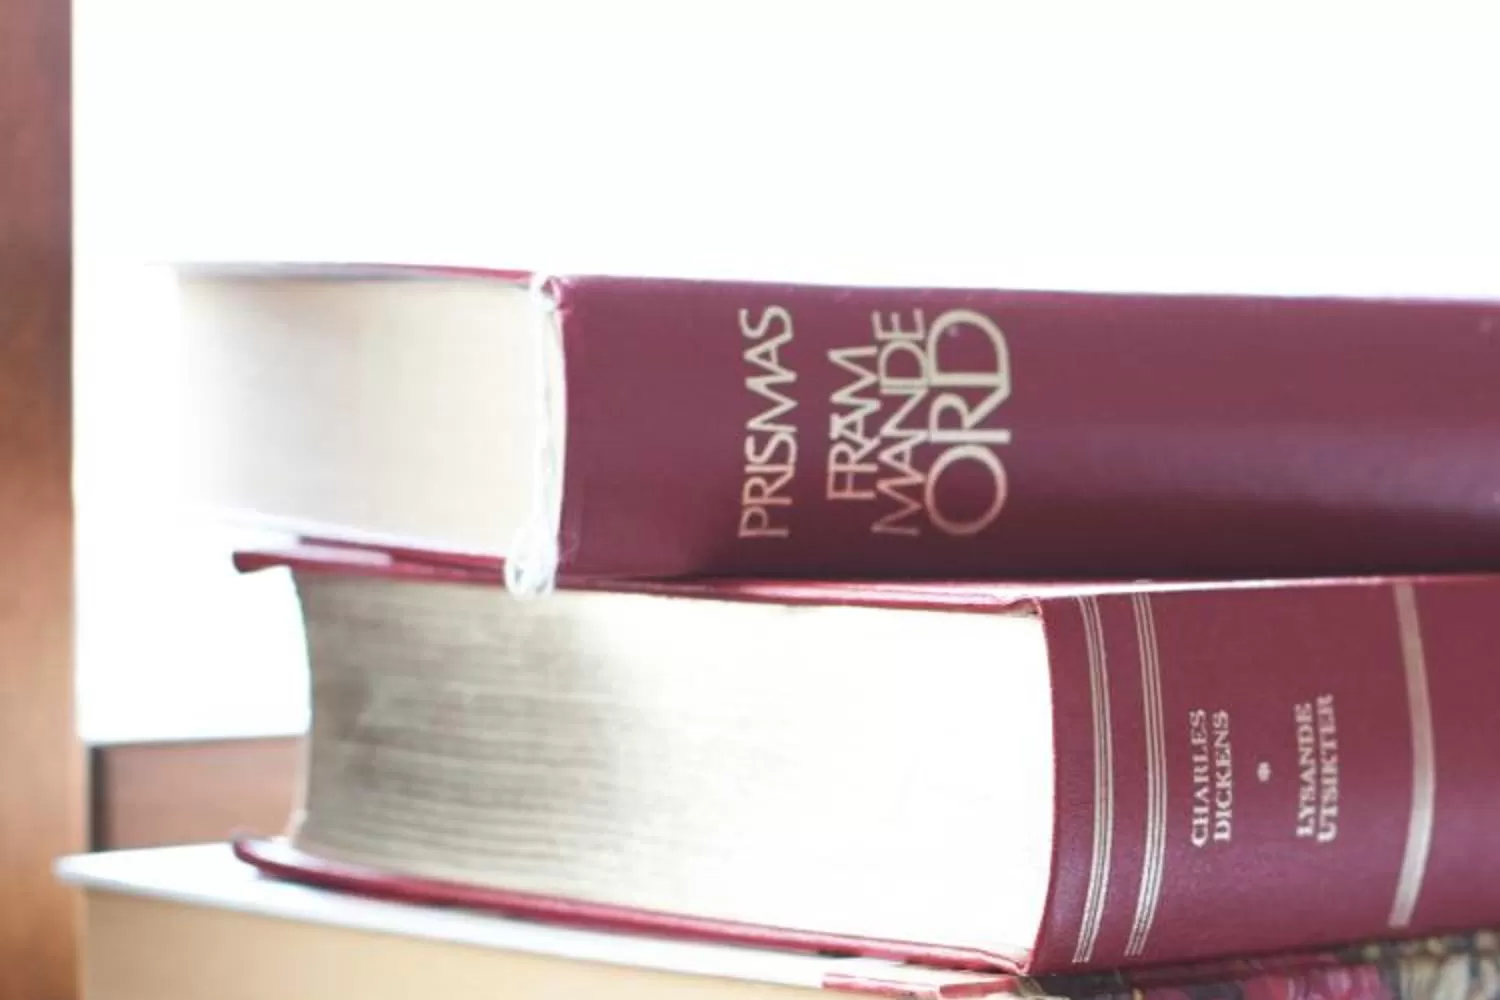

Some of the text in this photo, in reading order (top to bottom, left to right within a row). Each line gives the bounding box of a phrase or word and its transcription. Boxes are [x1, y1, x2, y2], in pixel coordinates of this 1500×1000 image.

[738, 306, 799, 538] PRISMAS
[870, 308, 929, 537] MANDE
[924, 308, 1011, 537] ORD
[1188, 708, 1210, 848] CHARLES
[1212, 708, 1233, 843] DICKENS
[1294, 702, 1316, 838] LYSANDE
[1316, 693, 1339, 843] UTSIKTER
